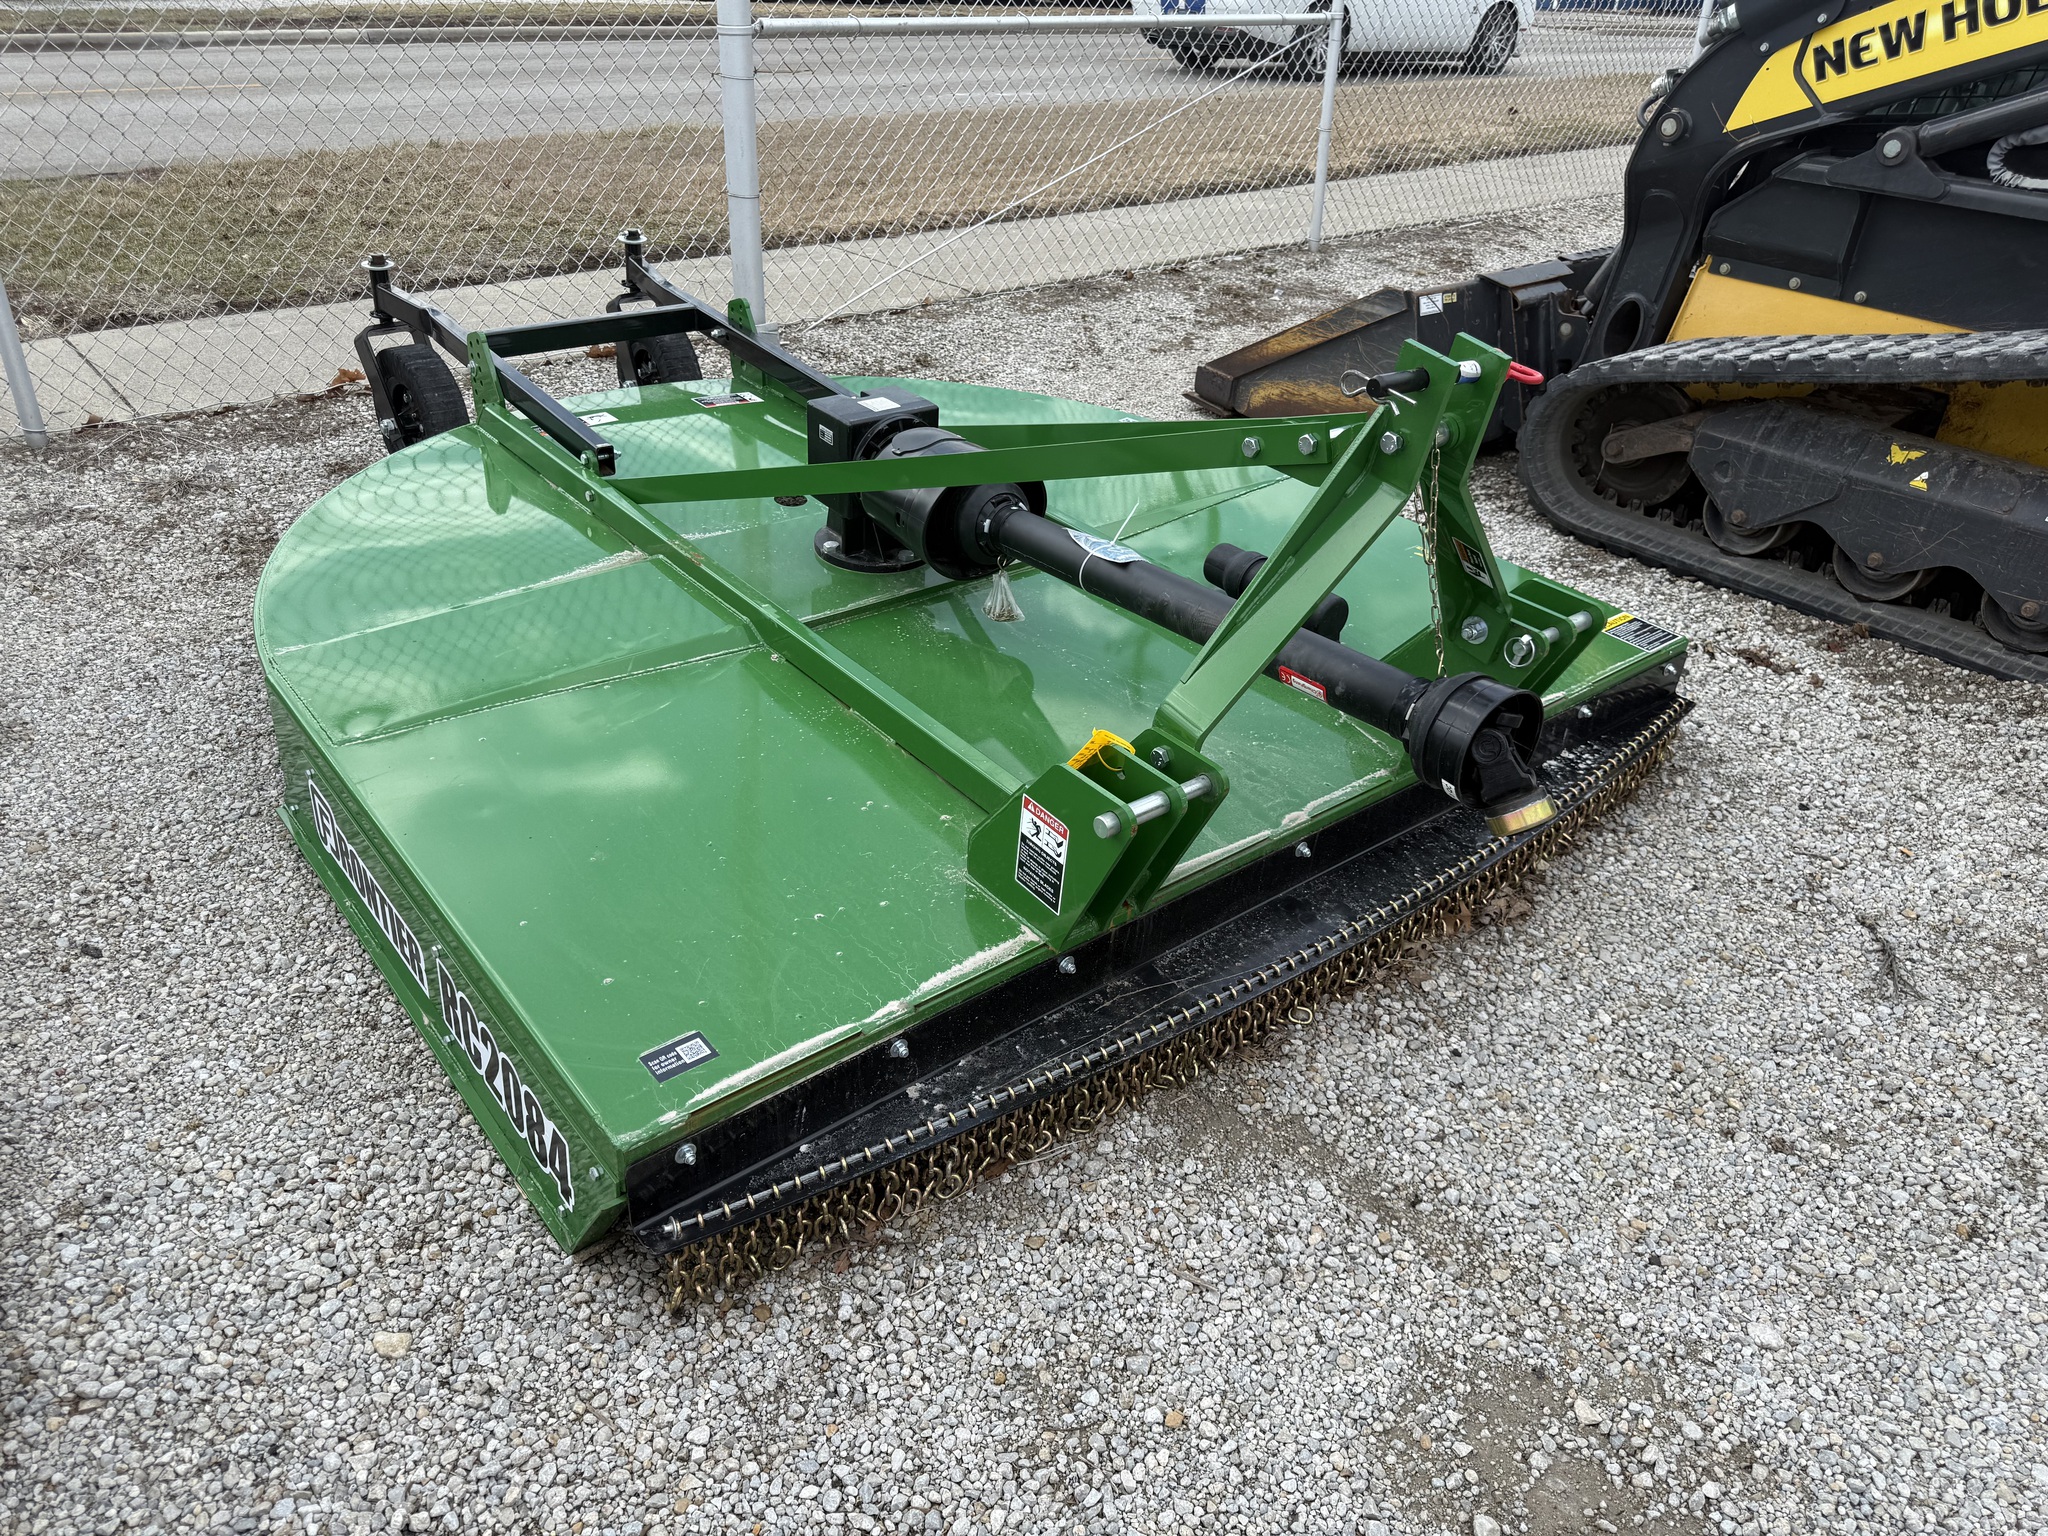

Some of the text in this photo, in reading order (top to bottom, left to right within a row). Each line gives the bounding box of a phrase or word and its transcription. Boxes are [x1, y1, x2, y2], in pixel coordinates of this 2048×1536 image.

[1812, 9, 1927, 83] NEW
[308, 779, 430, 999] FRONTIER
[1035, 807, 1065, 834] DANGER
[437, 957, 575, 1213] RC2084
